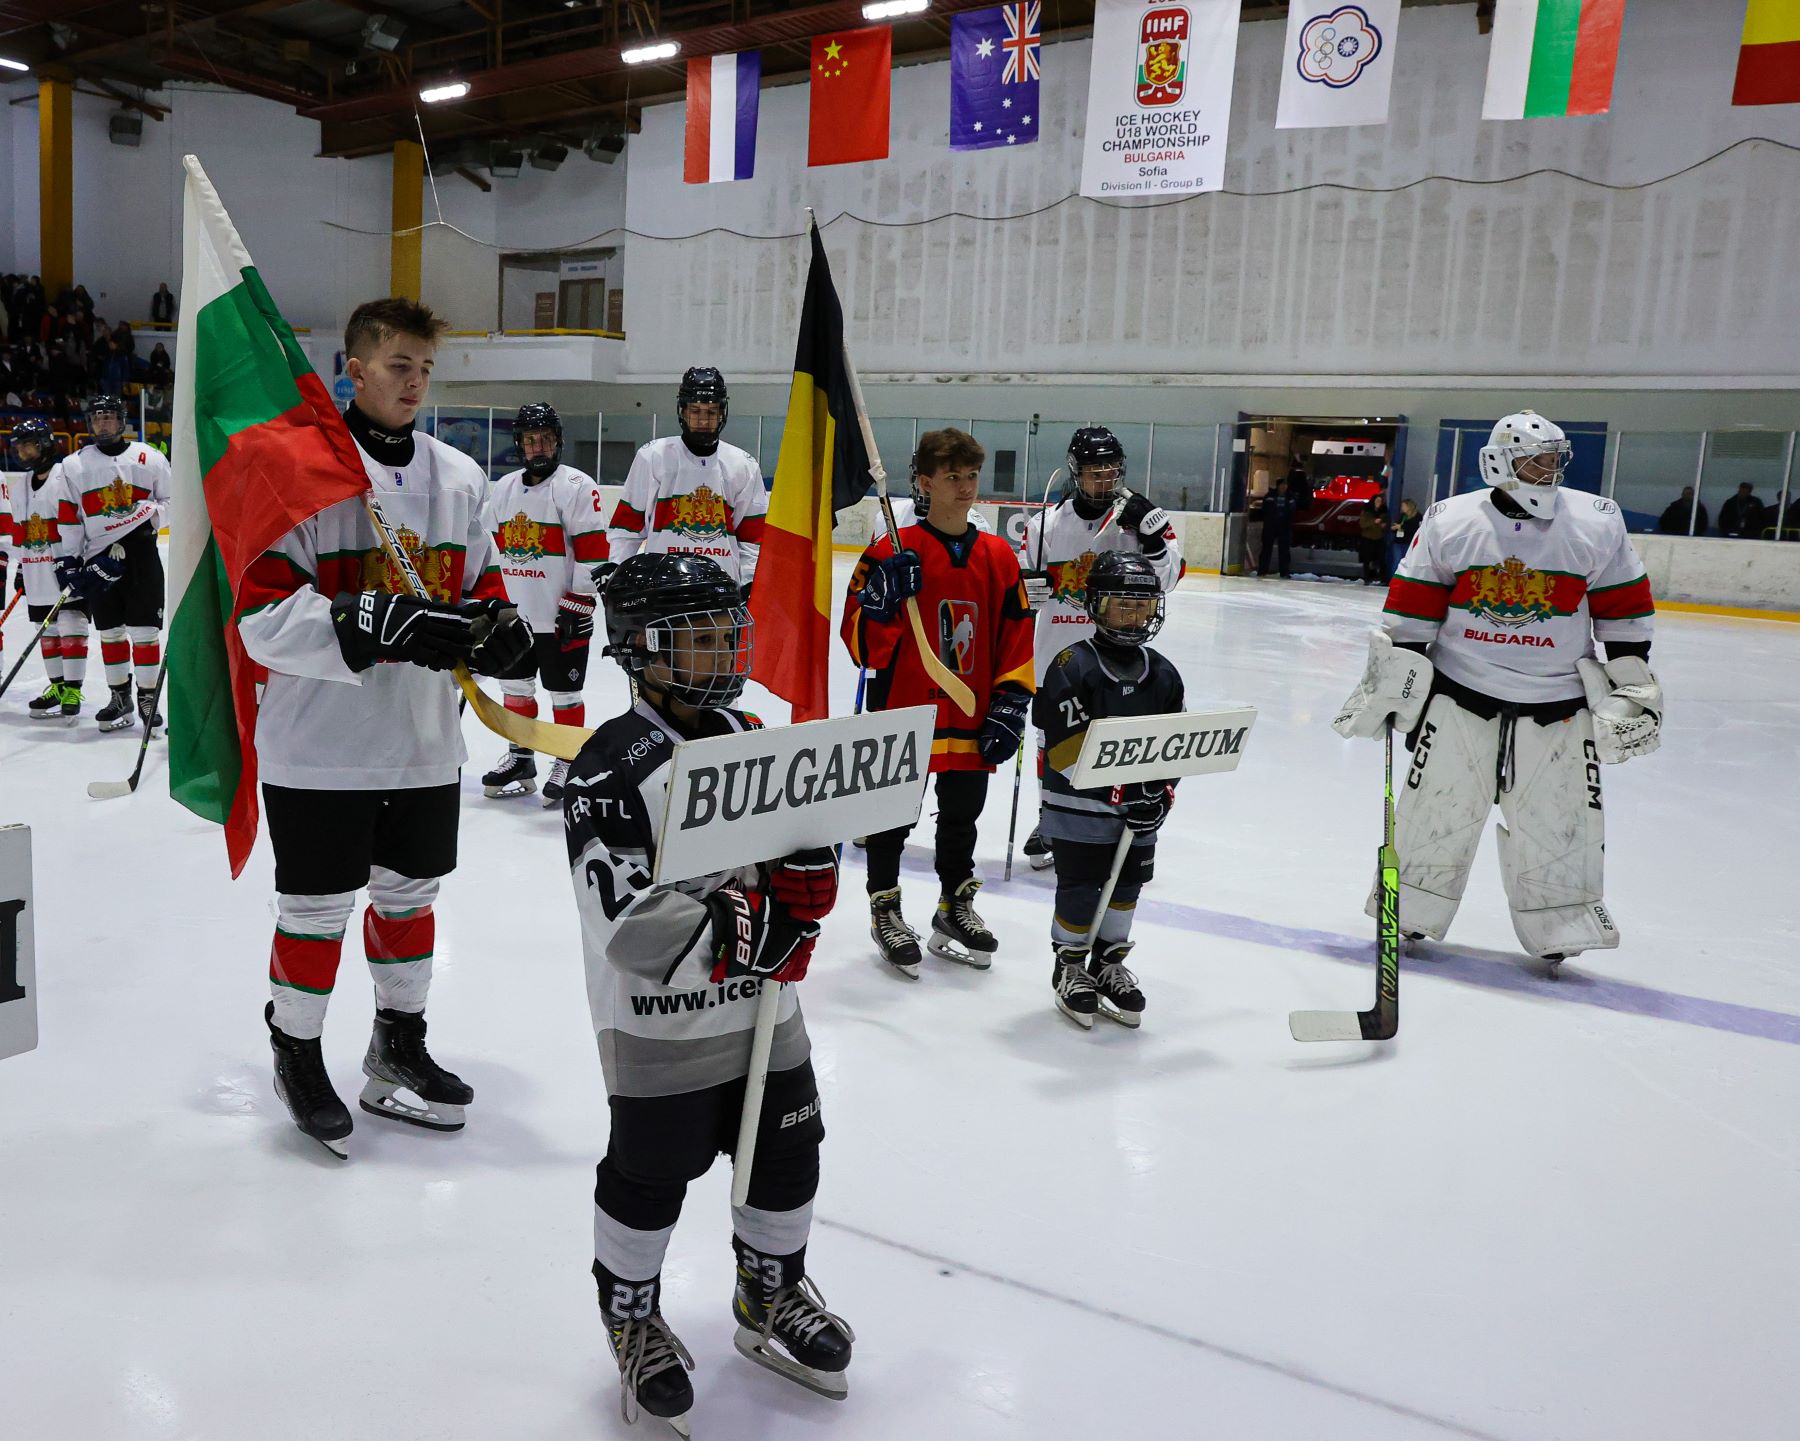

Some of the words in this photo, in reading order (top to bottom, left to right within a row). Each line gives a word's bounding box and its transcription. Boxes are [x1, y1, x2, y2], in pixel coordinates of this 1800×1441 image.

[1146, 16, 1185, 33] IIHF
[1116, 114, 1137, 127] ICE
[1142, 110, 1200, 125] HOCKEY
[1117, 127, 1142, 139] U18
[1146, 123, 1197, 136] WORLD
[1102, 135, 1210, 152] CHAMPIONSHIP
[1124, 151, 1185, 163] BULGARIA
[1138, 166, 1168, 178] Sofia
[1101, 180, 1142, 191] Division
[1160, 179, 1193, 190] Group
[1196, 178, 1203, 187] B
[138, 452, 146, 464] A
[1051, 615, 1095, 625] BULGA
[1463, 628, 1556, 648] BULGARIA
[1091, 726, 1249, 770] BELGIUM
[1407, 721, 1438, 790] CCM
[680, 730, 919, 832] BULGARIA
[1583, 739, 1602, 811] CCM
[742, 1249, 783, 1289] 23
[610, 1282, 656, 1320] 23
